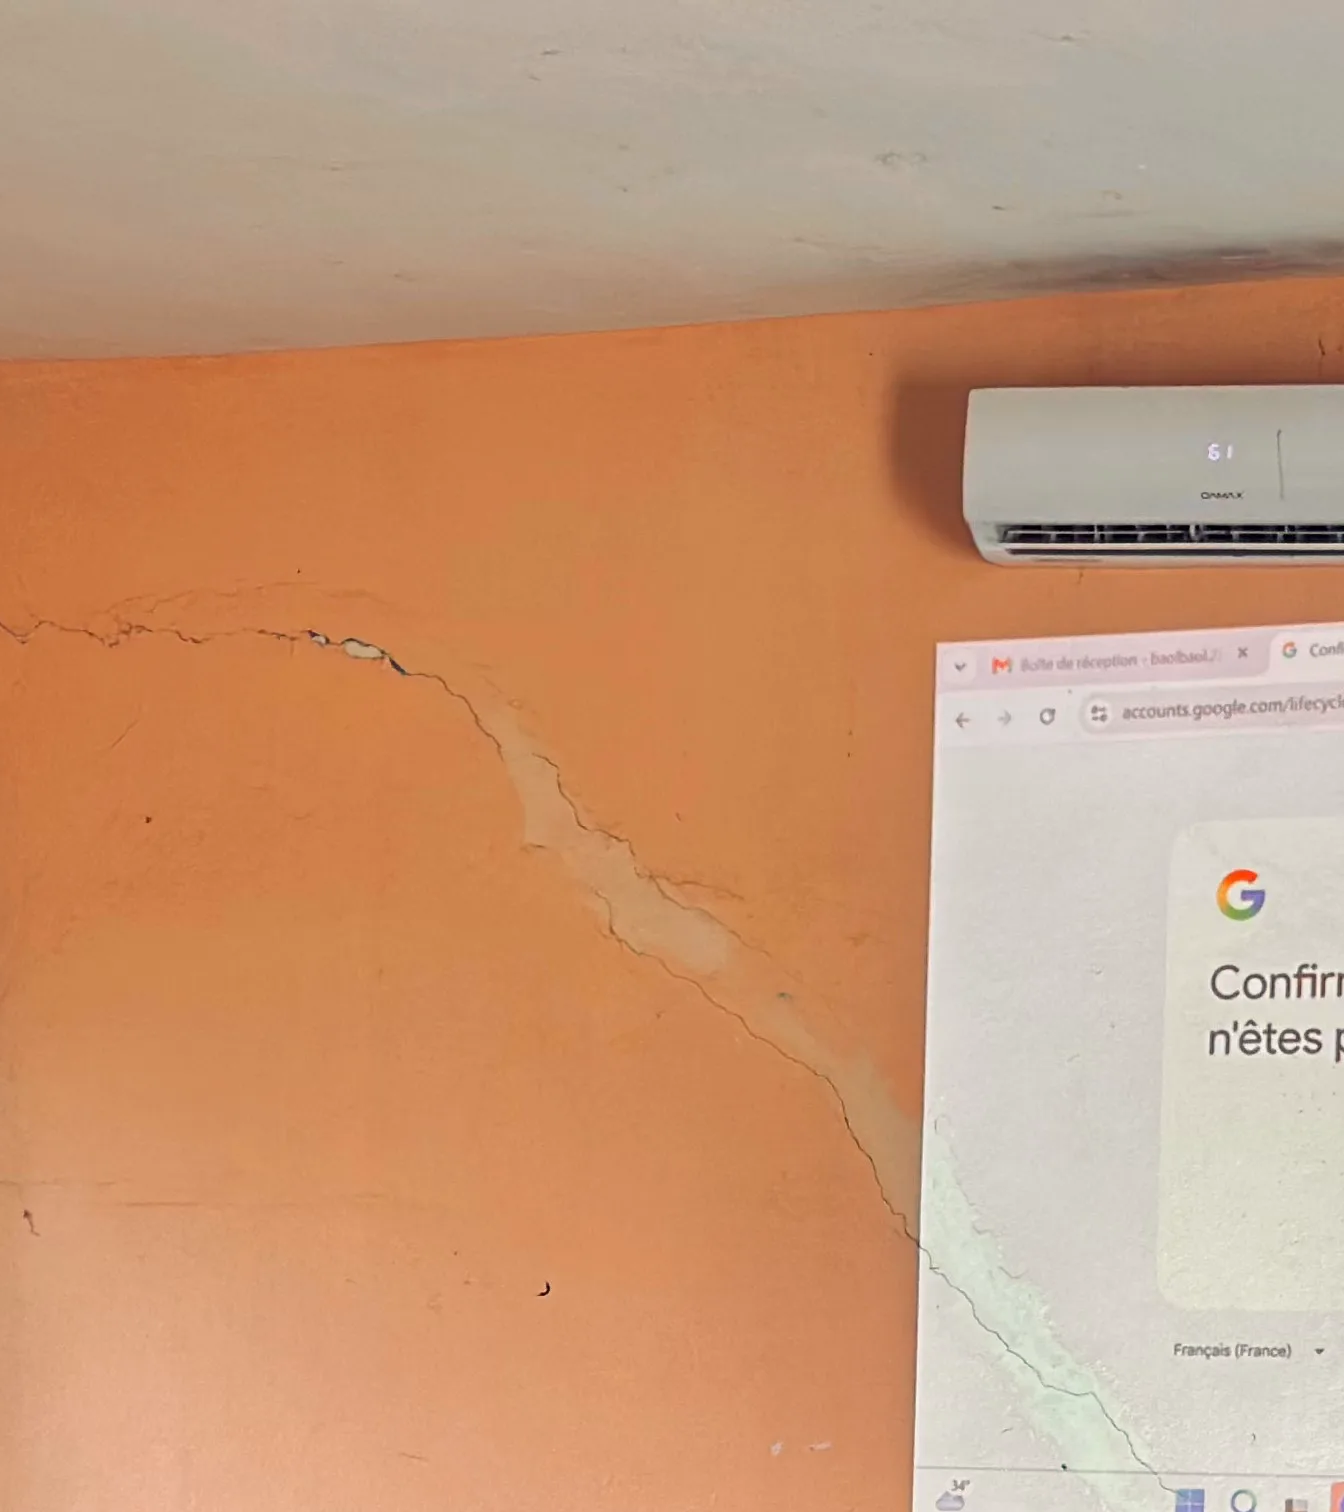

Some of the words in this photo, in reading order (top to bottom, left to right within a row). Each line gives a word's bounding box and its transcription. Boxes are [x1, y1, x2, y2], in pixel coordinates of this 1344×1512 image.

[1208, 1019, 1323, 1056] n'êtes
[1173, 1342, 1232, 1360] Français
[1234, 1343, 1292, 1359] (France)
